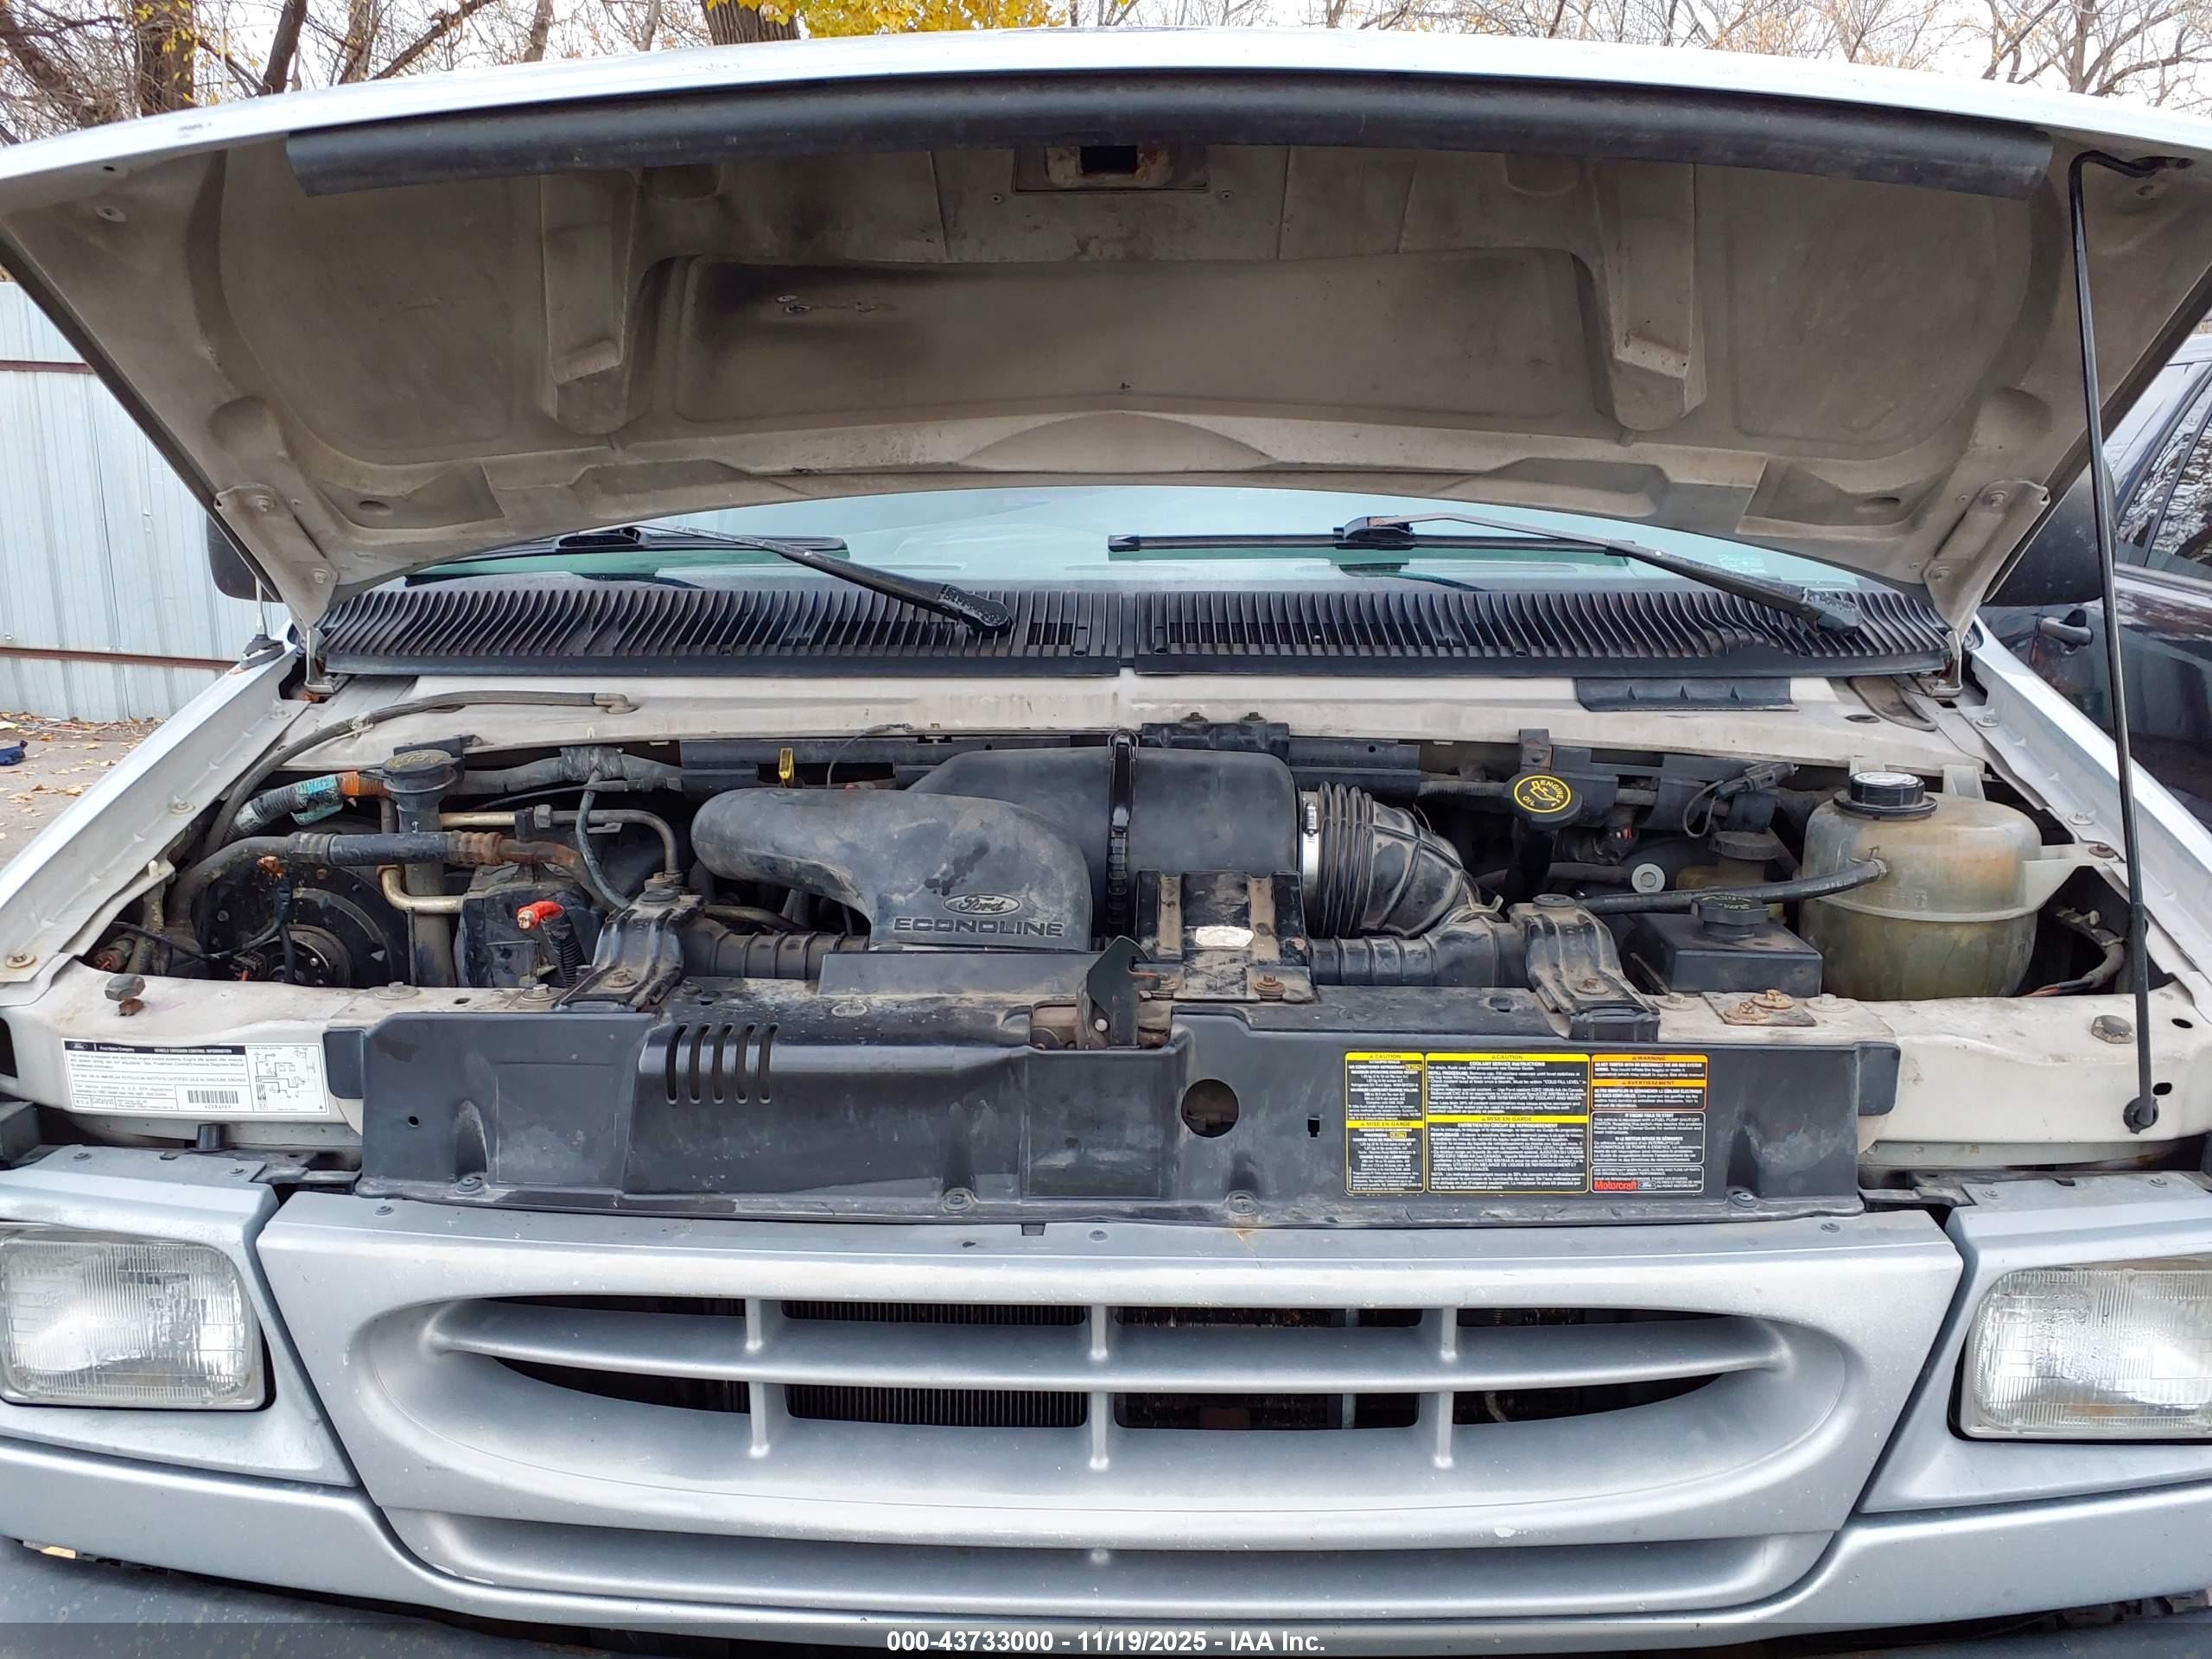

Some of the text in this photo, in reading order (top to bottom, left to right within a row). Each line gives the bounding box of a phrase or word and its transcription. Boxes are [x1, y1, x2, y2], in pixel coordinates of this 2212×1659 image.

[1540, 780, 1564, 799] ENGINE
[1522, 795, 1535, 807] OIL
[958, 894, 1006, 913] Ford
[893, 917, 1064, 938] ECONOLINE
[1594, 1181, 1637, 1190] Motorcraft
